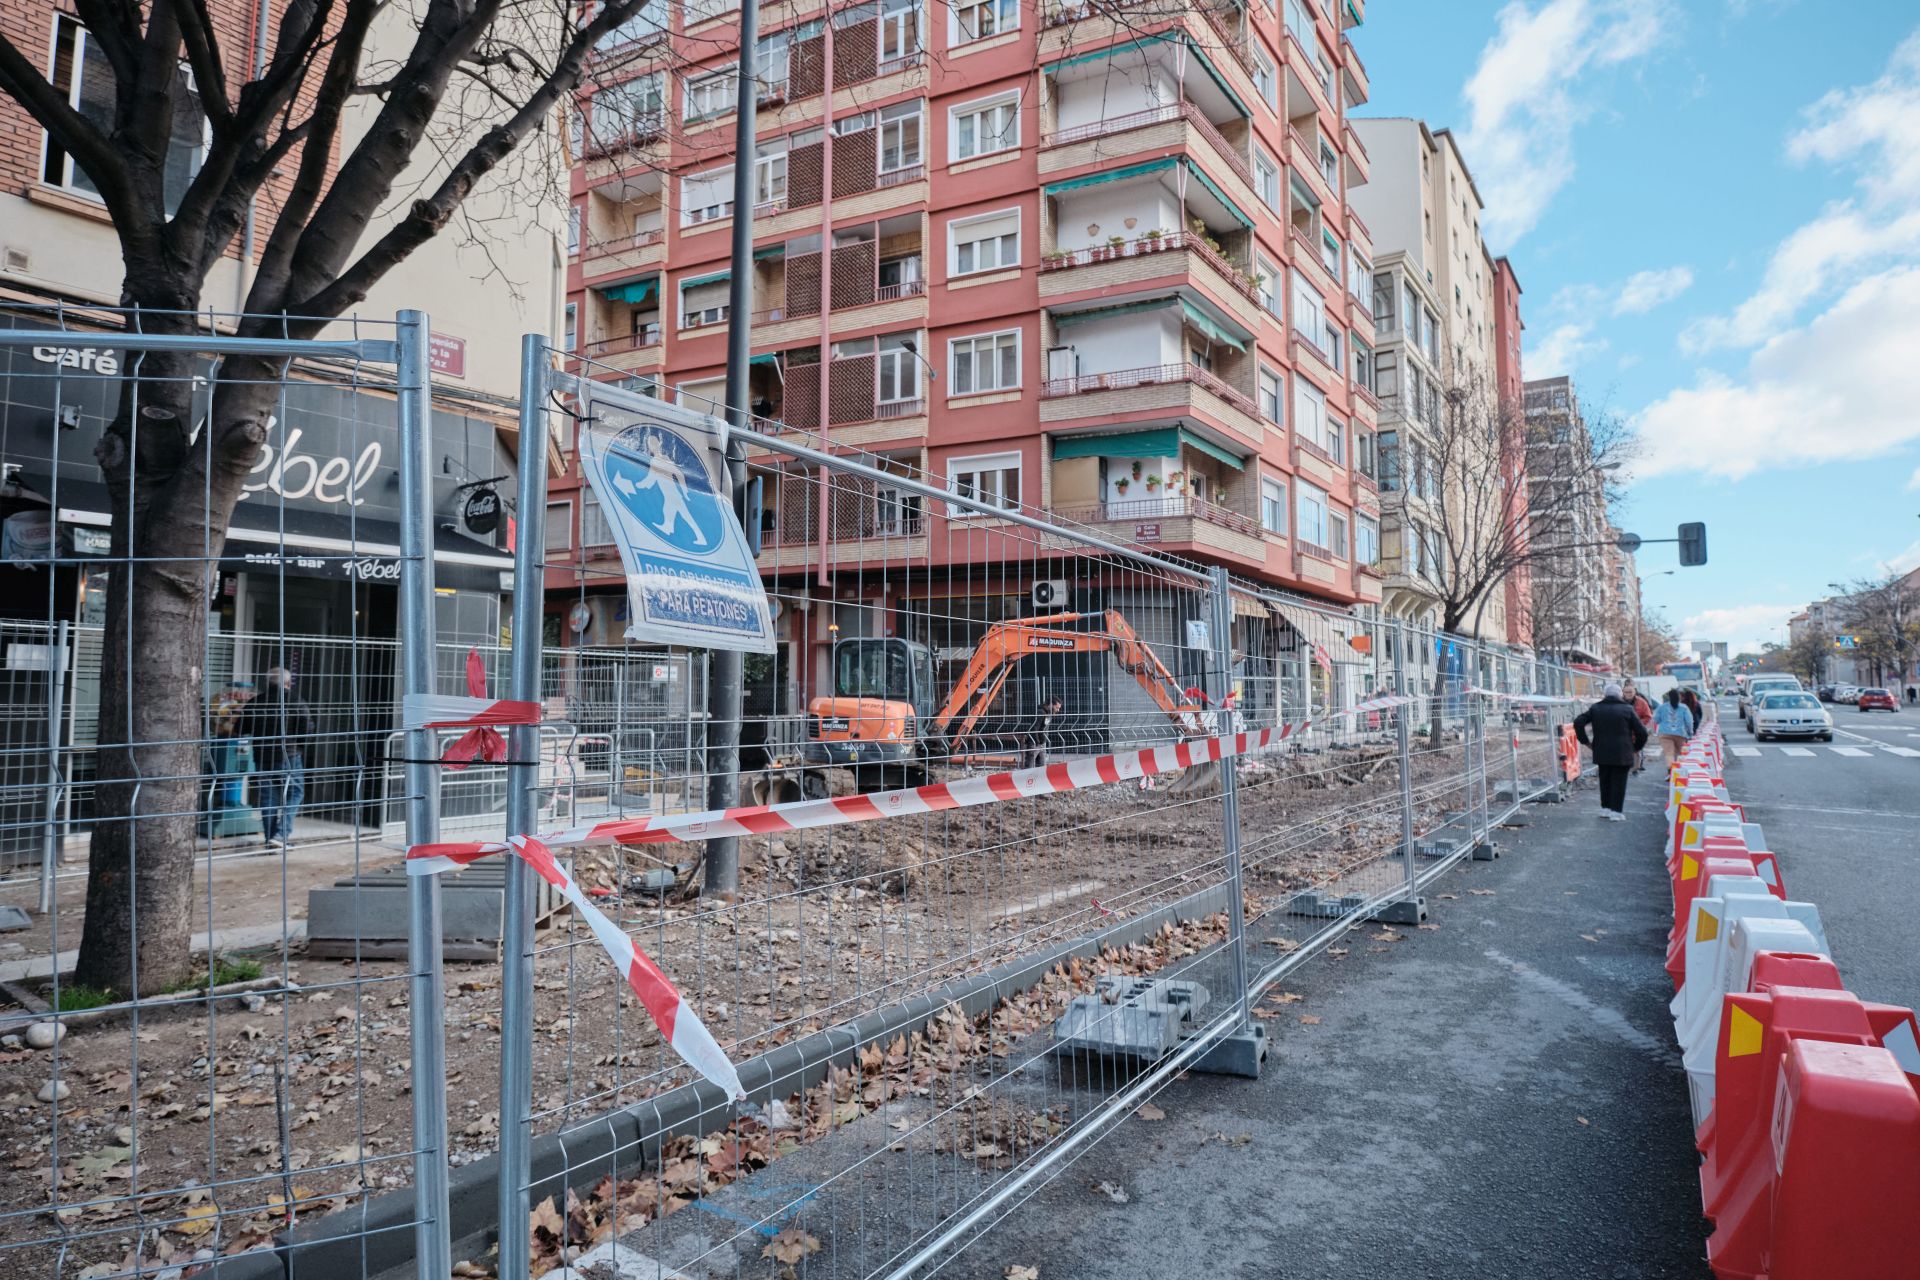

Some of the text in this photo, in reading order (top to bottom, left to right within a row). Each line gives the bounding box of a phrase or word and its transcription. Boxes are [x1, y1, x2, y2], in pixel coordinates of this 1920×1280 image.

[430, 337, 459, 350] venida
[440, 348, 450, 358] la
[32, 346, 118, 375] café
[190, 415, 381, 506] ebel
[659, 590, 692, 614] PARA
[692, 596, 748, 621] PEATONES
[965, 663, 985, 689] AQUILER
